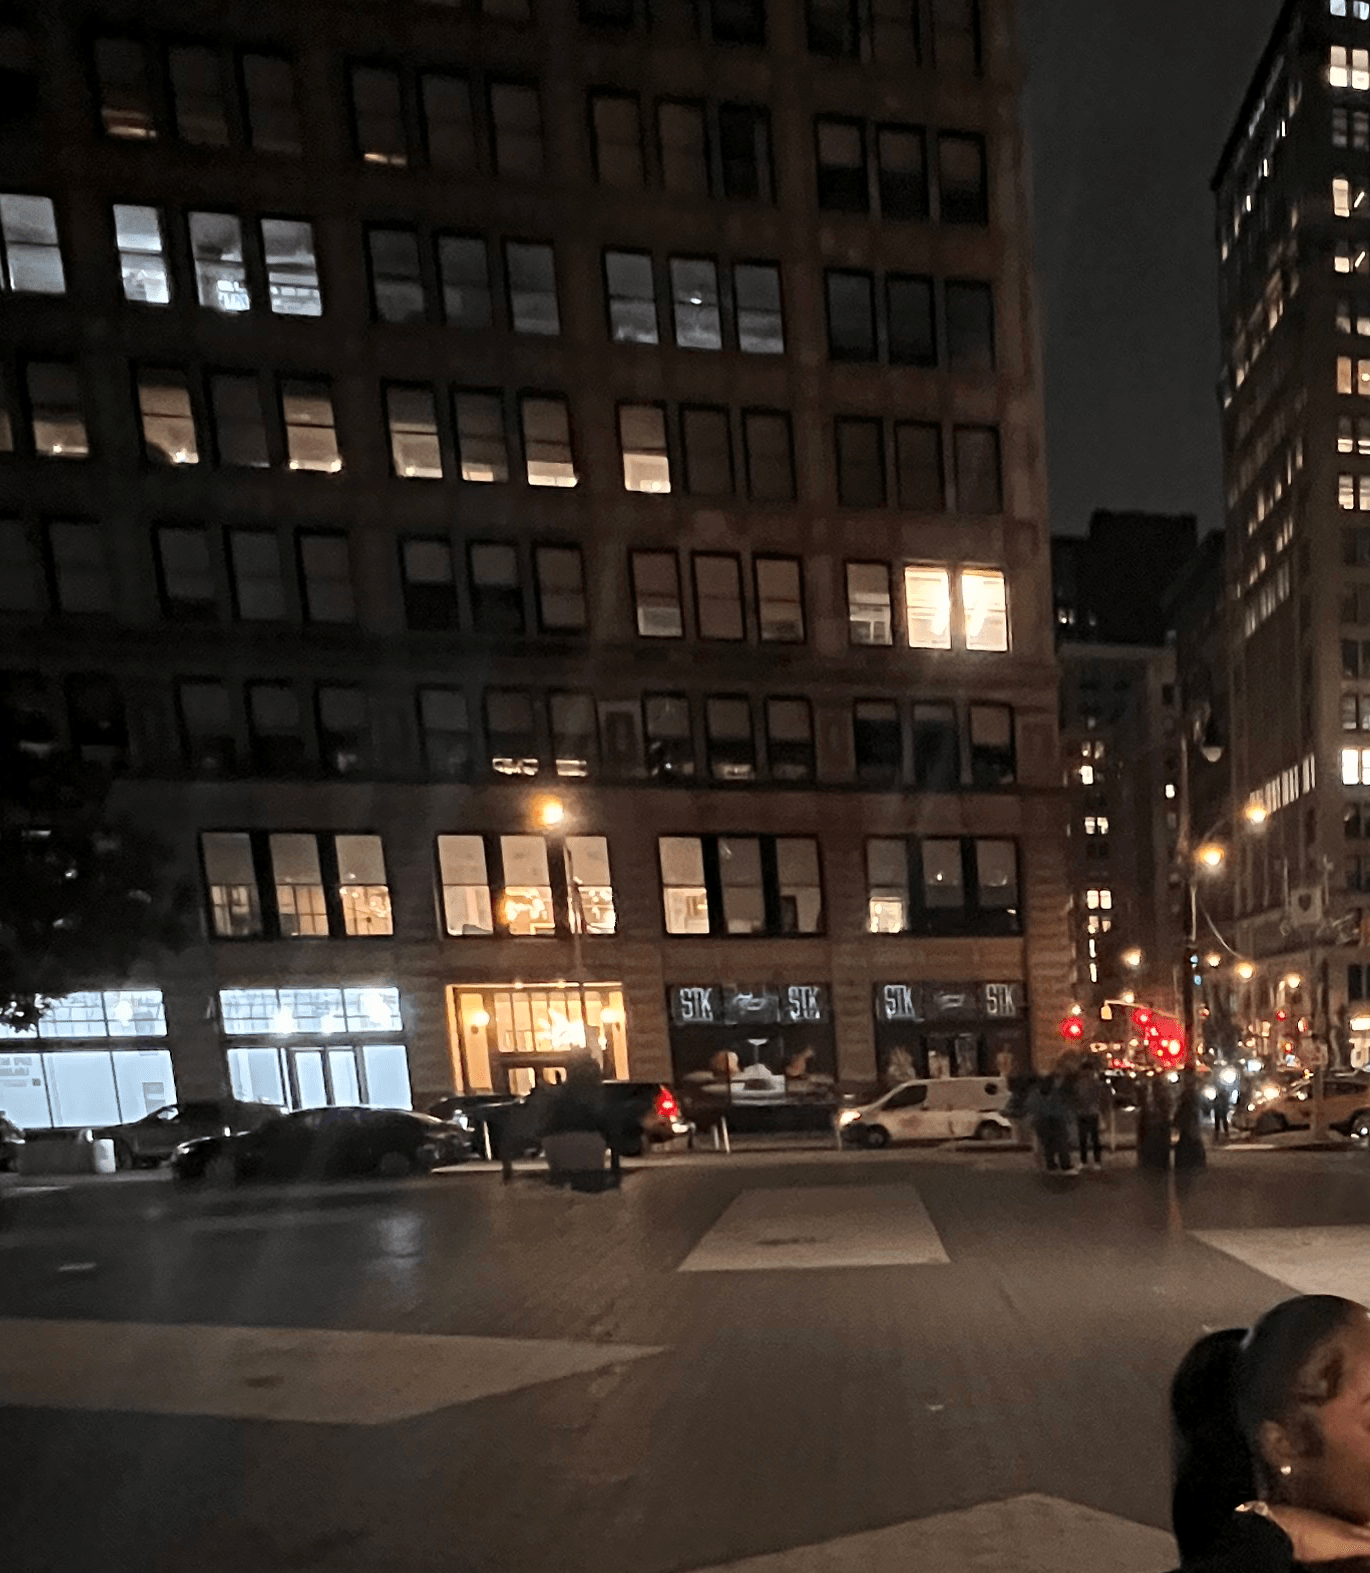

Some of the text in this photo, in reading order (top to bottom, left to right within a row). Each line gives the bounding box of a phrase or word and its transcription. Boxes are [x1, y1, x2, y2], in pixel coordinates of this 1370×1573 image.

[679, 987, 714, 1021] STK
[788, 986, 821, 1020] STK
[884, 984, 916, 1020] STK
[986, 983, 1017, 1017] STK
